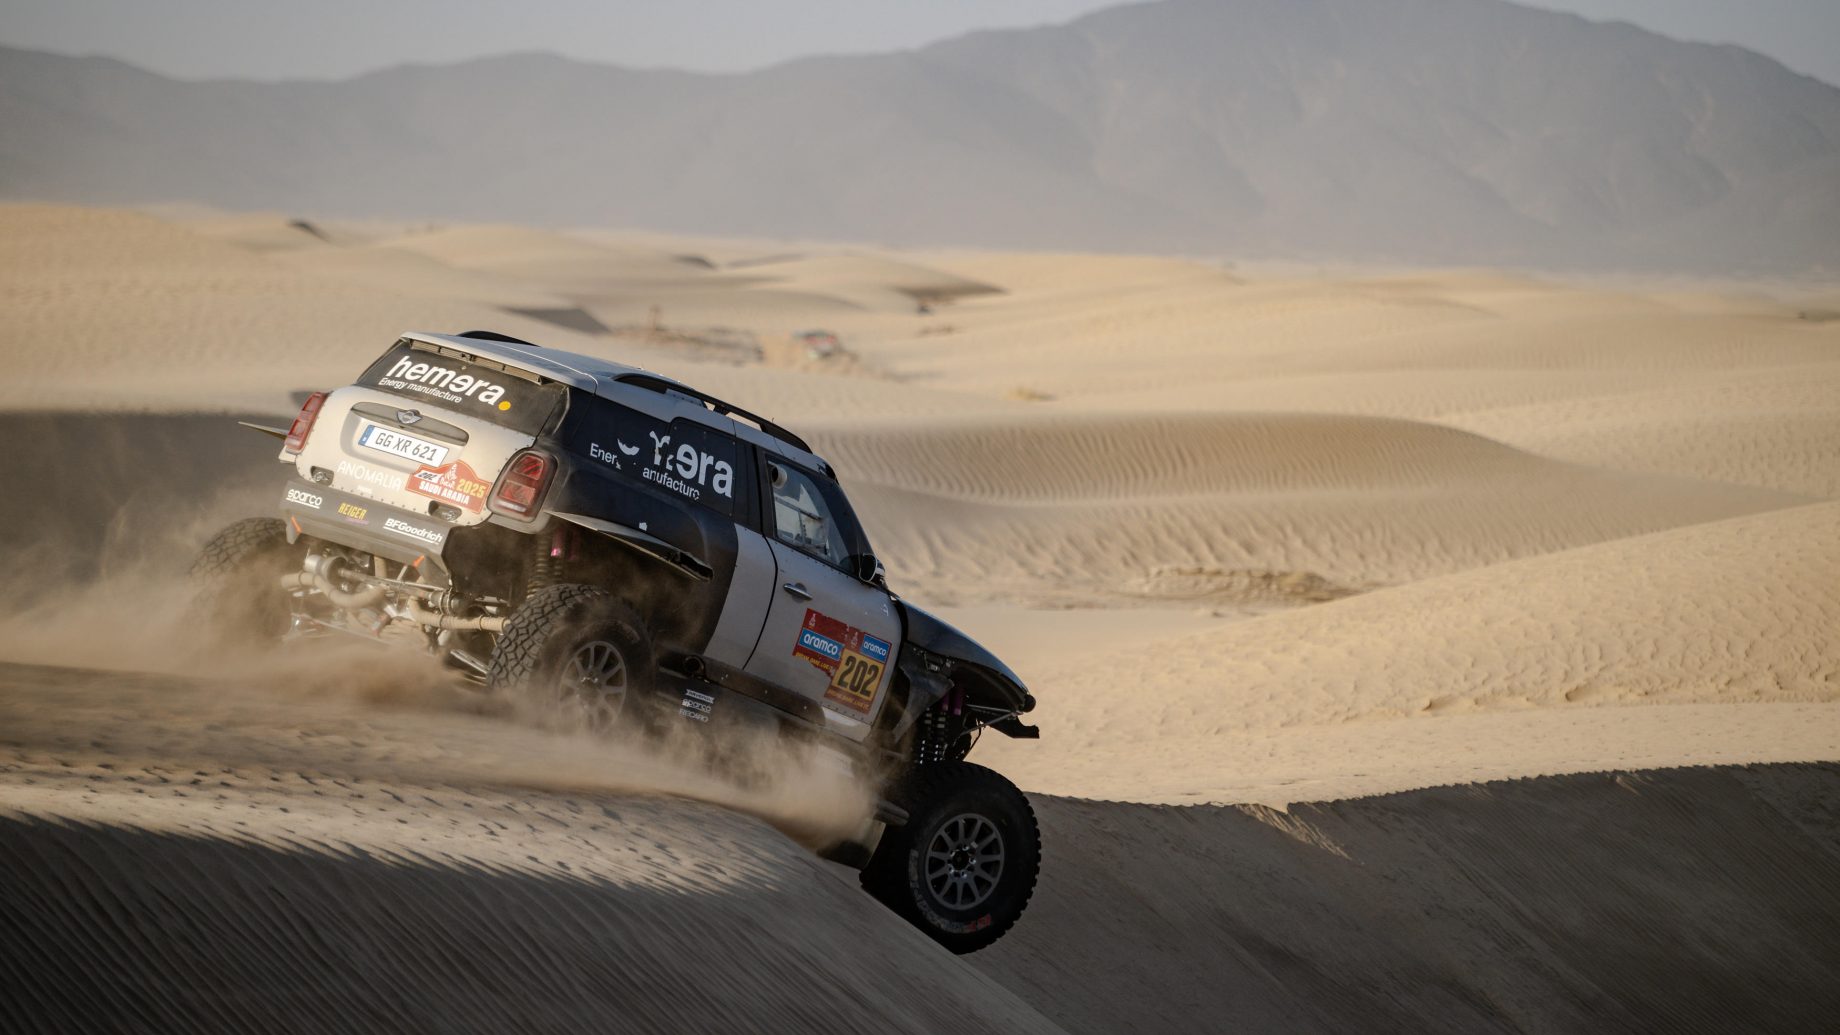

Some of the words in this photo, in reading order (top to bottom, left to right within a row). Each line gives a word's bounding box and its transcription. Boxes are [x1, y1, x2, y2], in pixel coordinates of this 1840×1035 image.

[378, 377, 408, 389] Energy
[406, 382, 462, 403] manufacture
[375, 431, 394, 448] GG
[394, 437, 412, 453] XR
[412, 443, 438, 462] 621
[589, 442, 622, 470] Ener
[336, 460, 402, 491] ANOMALIA
[456, 478, 487, 499] 2025
[286, 488, 323, 507] sparco
[418, 481, 442, 495] SAUDI
[441, 487, 470, 505] ARABIA
[384, 517, 444, 544] BFGoodrich
[803, 633, 839, 656] aramco
[863, 641, 887, 657] aramco
[837, 655, 880, 697] 202
